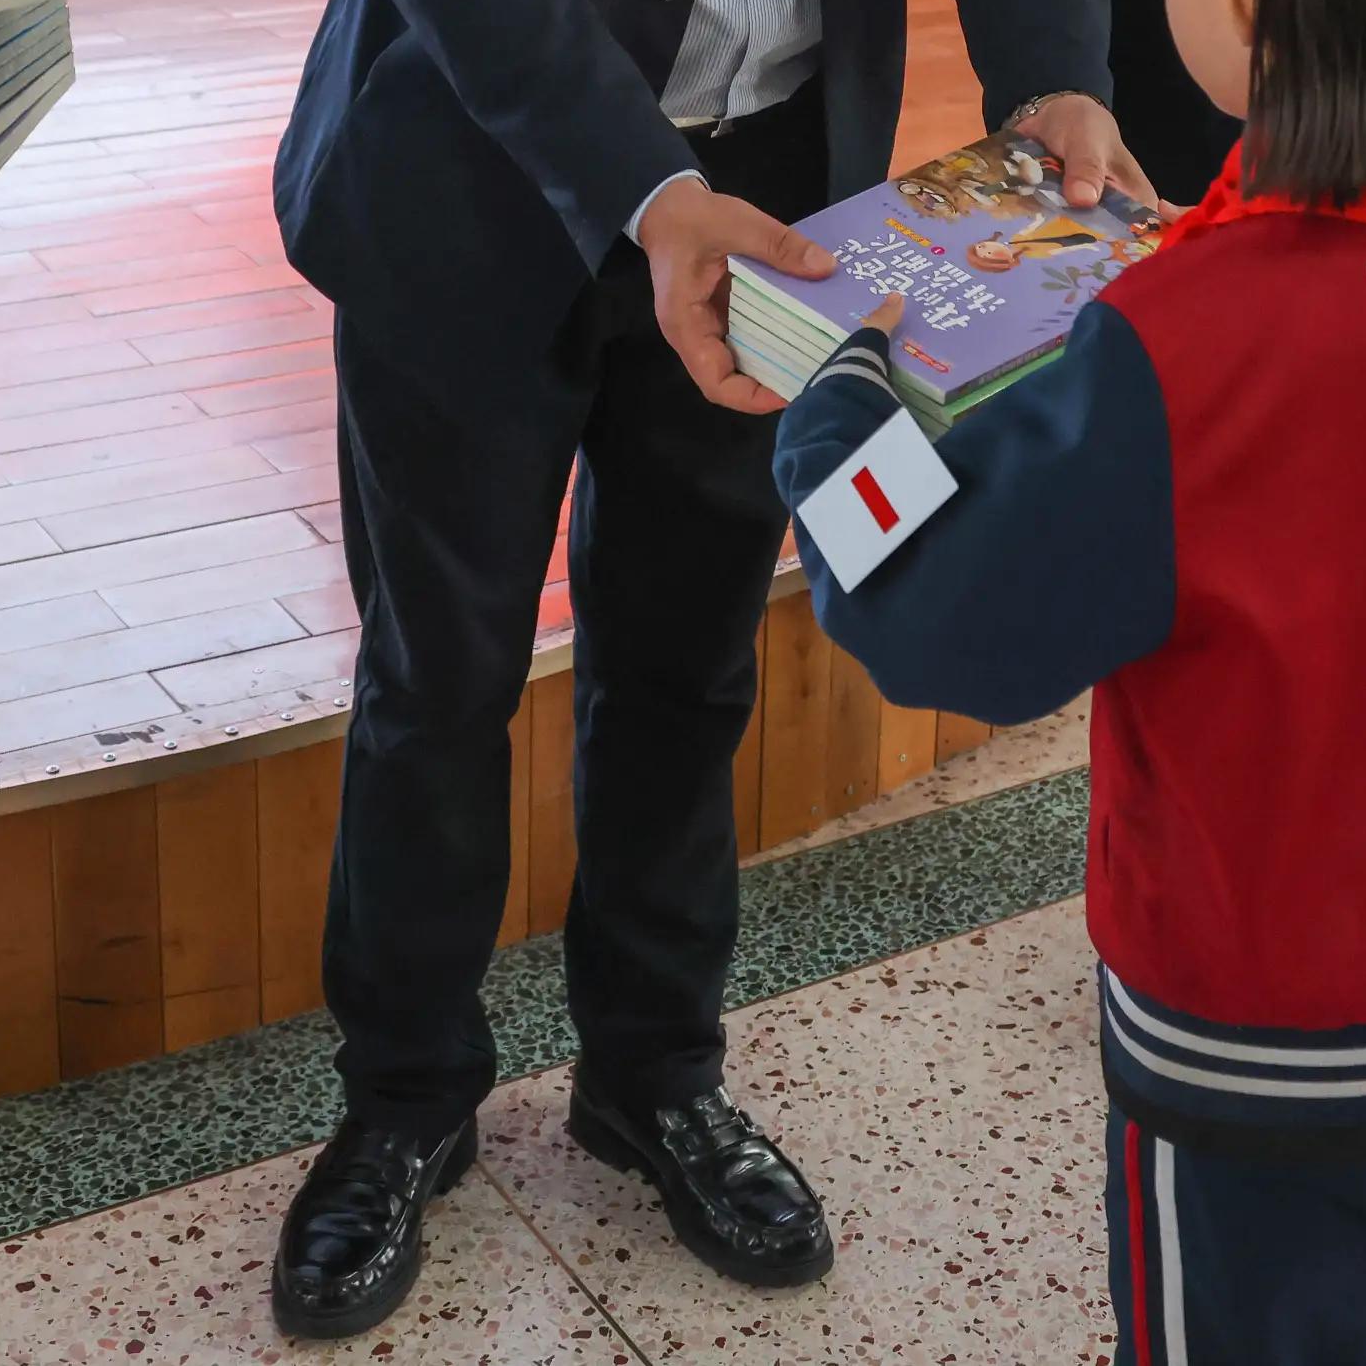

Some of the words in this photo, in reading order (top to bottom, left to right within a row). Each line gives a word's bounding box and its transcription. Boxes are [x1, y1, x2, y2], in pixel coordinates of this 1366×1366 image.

[834, 238, 972, 331] 我的爸爸是
[870, 234, 1006, 314] 海盗船长
